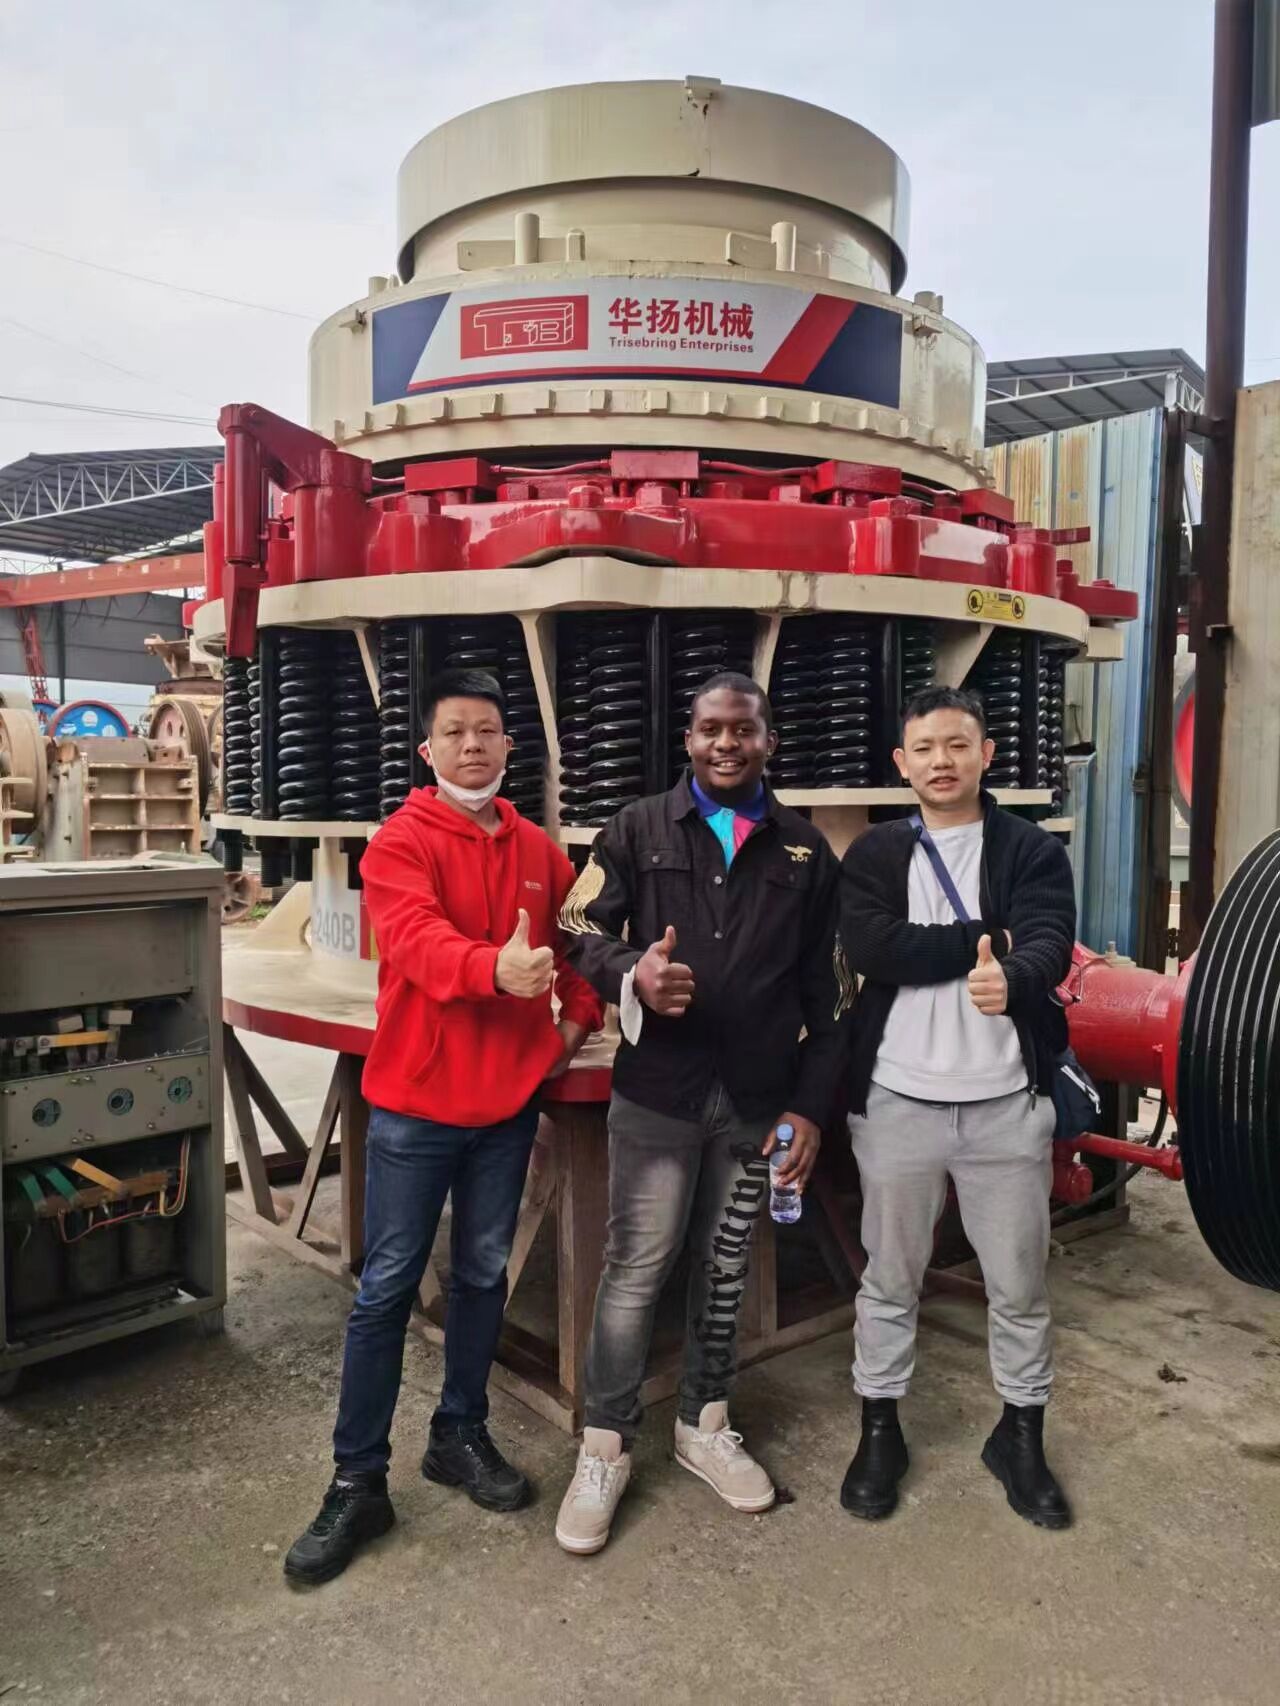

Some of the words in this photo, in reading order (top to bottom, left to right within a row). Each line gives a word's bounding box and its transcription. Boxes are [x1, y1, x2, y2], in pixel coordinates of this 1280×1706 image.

[608, 297, 754, 339] 华扬机械
[609, 336, 677, 351] Trisebring
[680, 338, 755, 353] Enterprises
